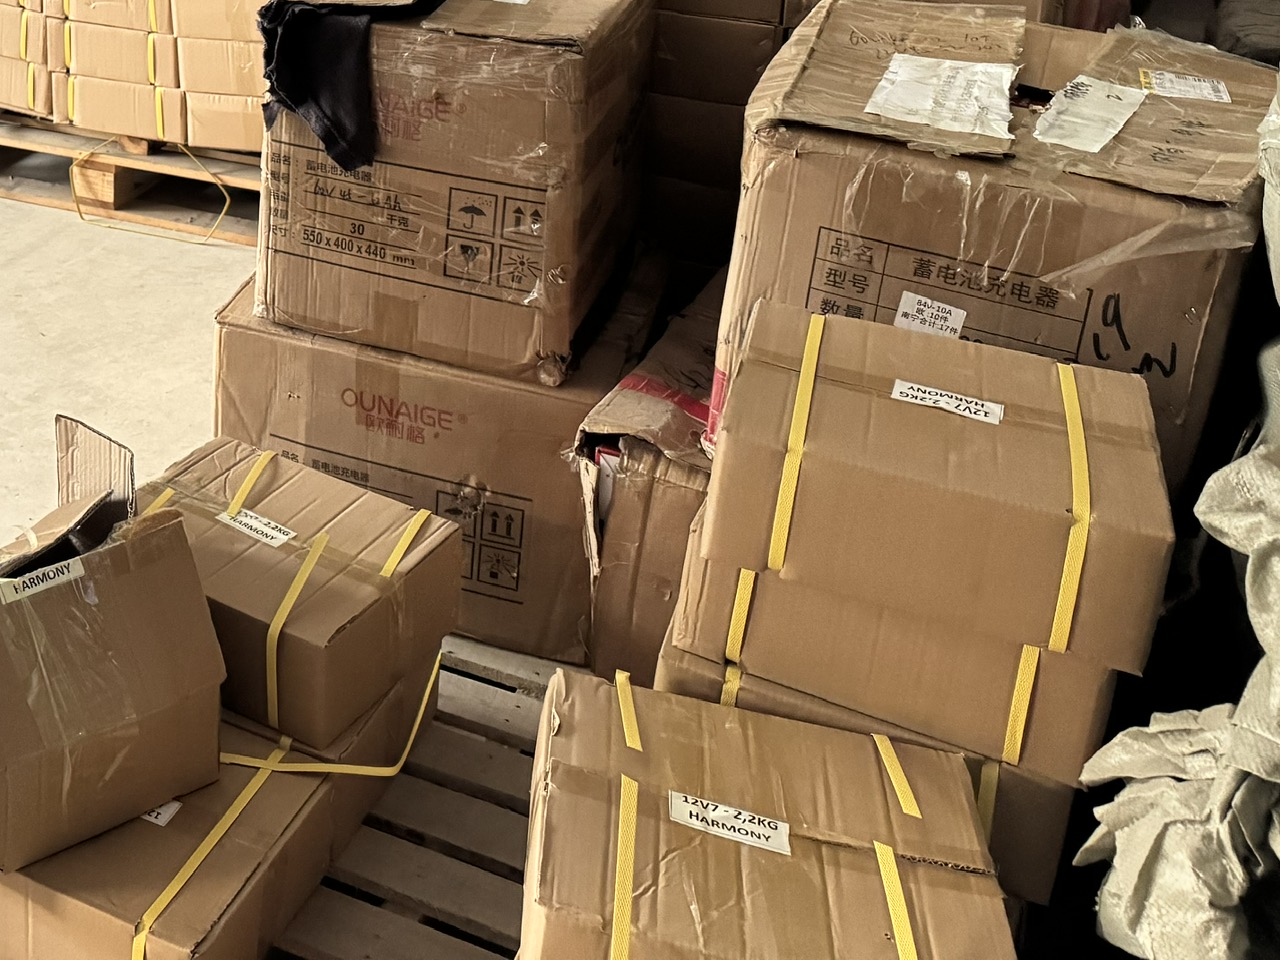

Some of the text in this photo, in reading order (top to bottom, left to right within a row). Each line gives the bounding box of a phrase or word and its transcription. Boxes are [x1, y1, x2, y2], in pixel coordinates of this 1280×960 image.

[302, 228, 322, 245] 550
[333, 236, 354, 253] 400
[365, 245, 387, 260] 440
[350, 222, 365, 237] 30
[823, 267, 870, 295] 型号
[829, 237, 1061, 310] 品名 蓄电池充电器
[340, 387, 454, 432] OUNAIGE
[907, 385, 985, 409] HARMONY
[954, 403, 990, 418] 12V7
[229, 516, 277, 541] HARMONY
[13, 562, 71, 594] HARMONY
[682, 795, 719, 812] 12V7
[733, 809, 778, 831] 2,2KG
[688, 810, 772, 842] HARMONY
